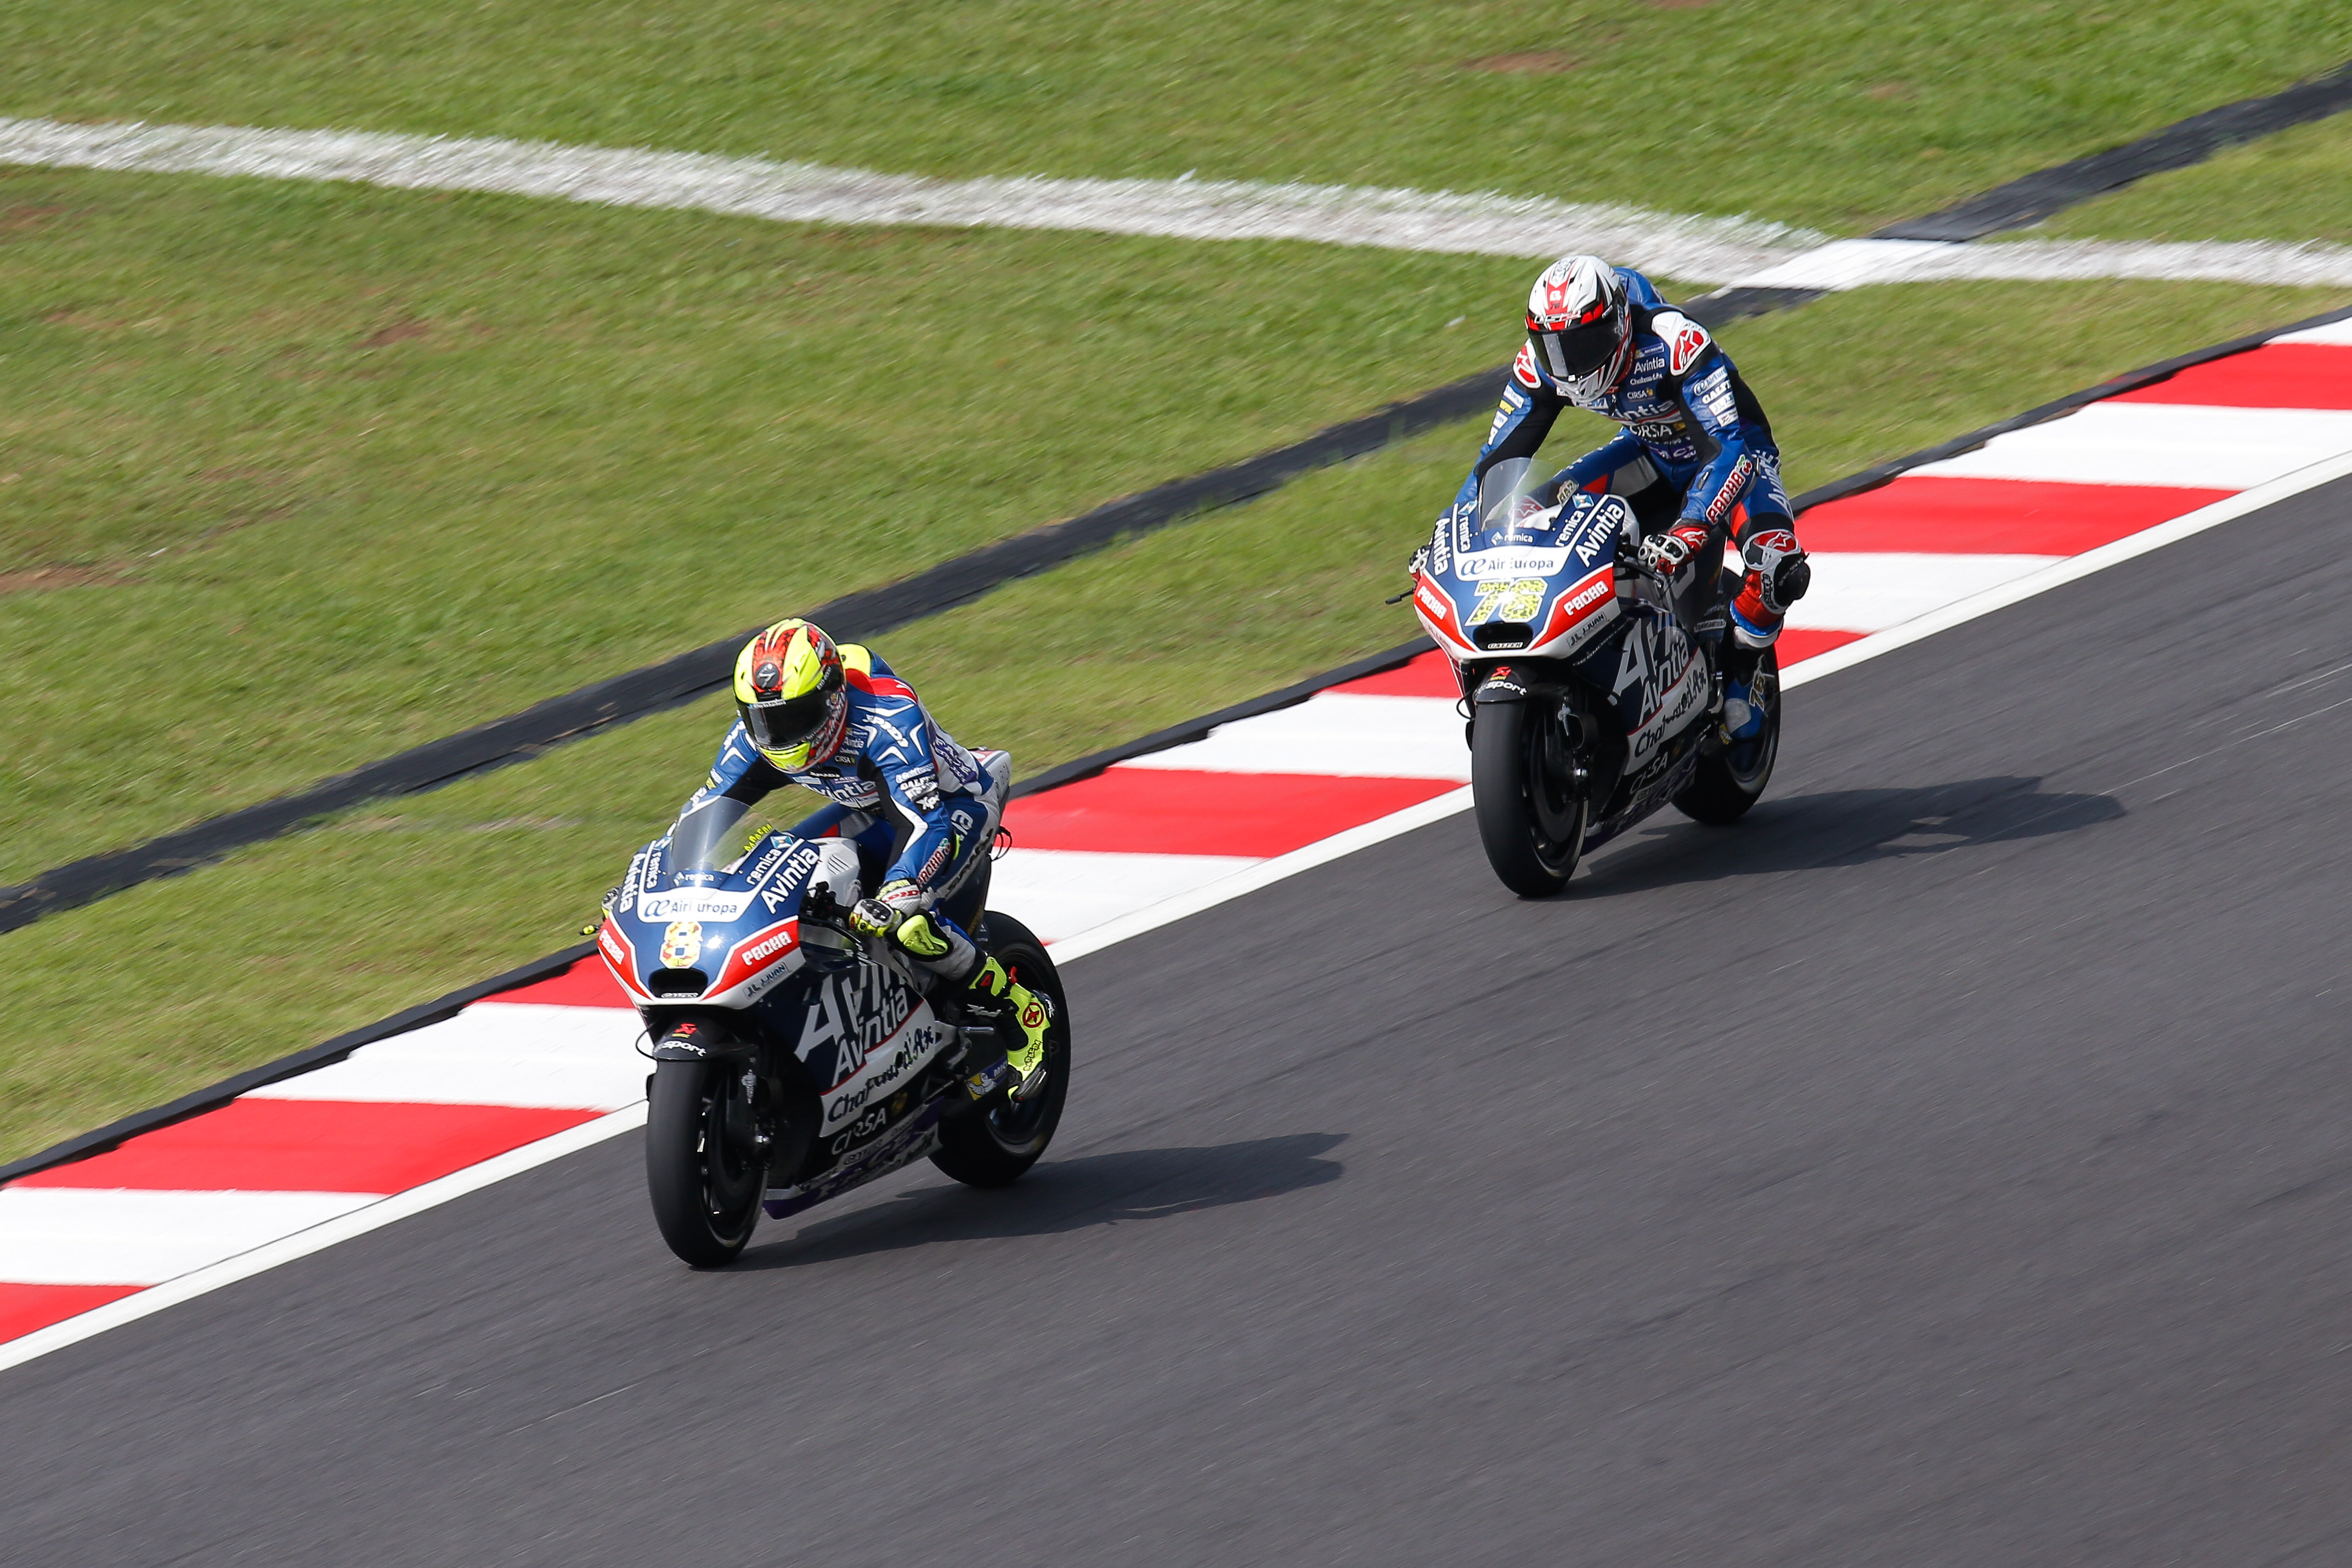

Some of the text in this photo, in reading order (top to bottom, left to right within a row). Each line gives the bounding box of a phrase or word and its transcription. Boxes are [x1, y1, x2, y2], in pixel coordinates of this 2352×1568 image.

[1634, 357, 1665, 375] Avintia
[1627, 390, 1647, 399] CIRSA
[1433, 517, 1451, 576] Avintia
[1459, 516, 1473, 552] remica
[1555, 510, 1585, 547] remica
[1575, 503, 1624, 568] Avintia
[1417, 585, 1448, 620] PACHA
[1465, 577, 1548, 626] 76
[1563, 580, 1609, 616] PACHA
[619, 853, 646, 913] Avintia
[646, 851, 663, 889] remica
[746, 847, 783, 885] remica
[761, 847, 819, 915] Avintia
[659, 921, 703, 969] 8
[742, 931, 792, 966] PACHA
